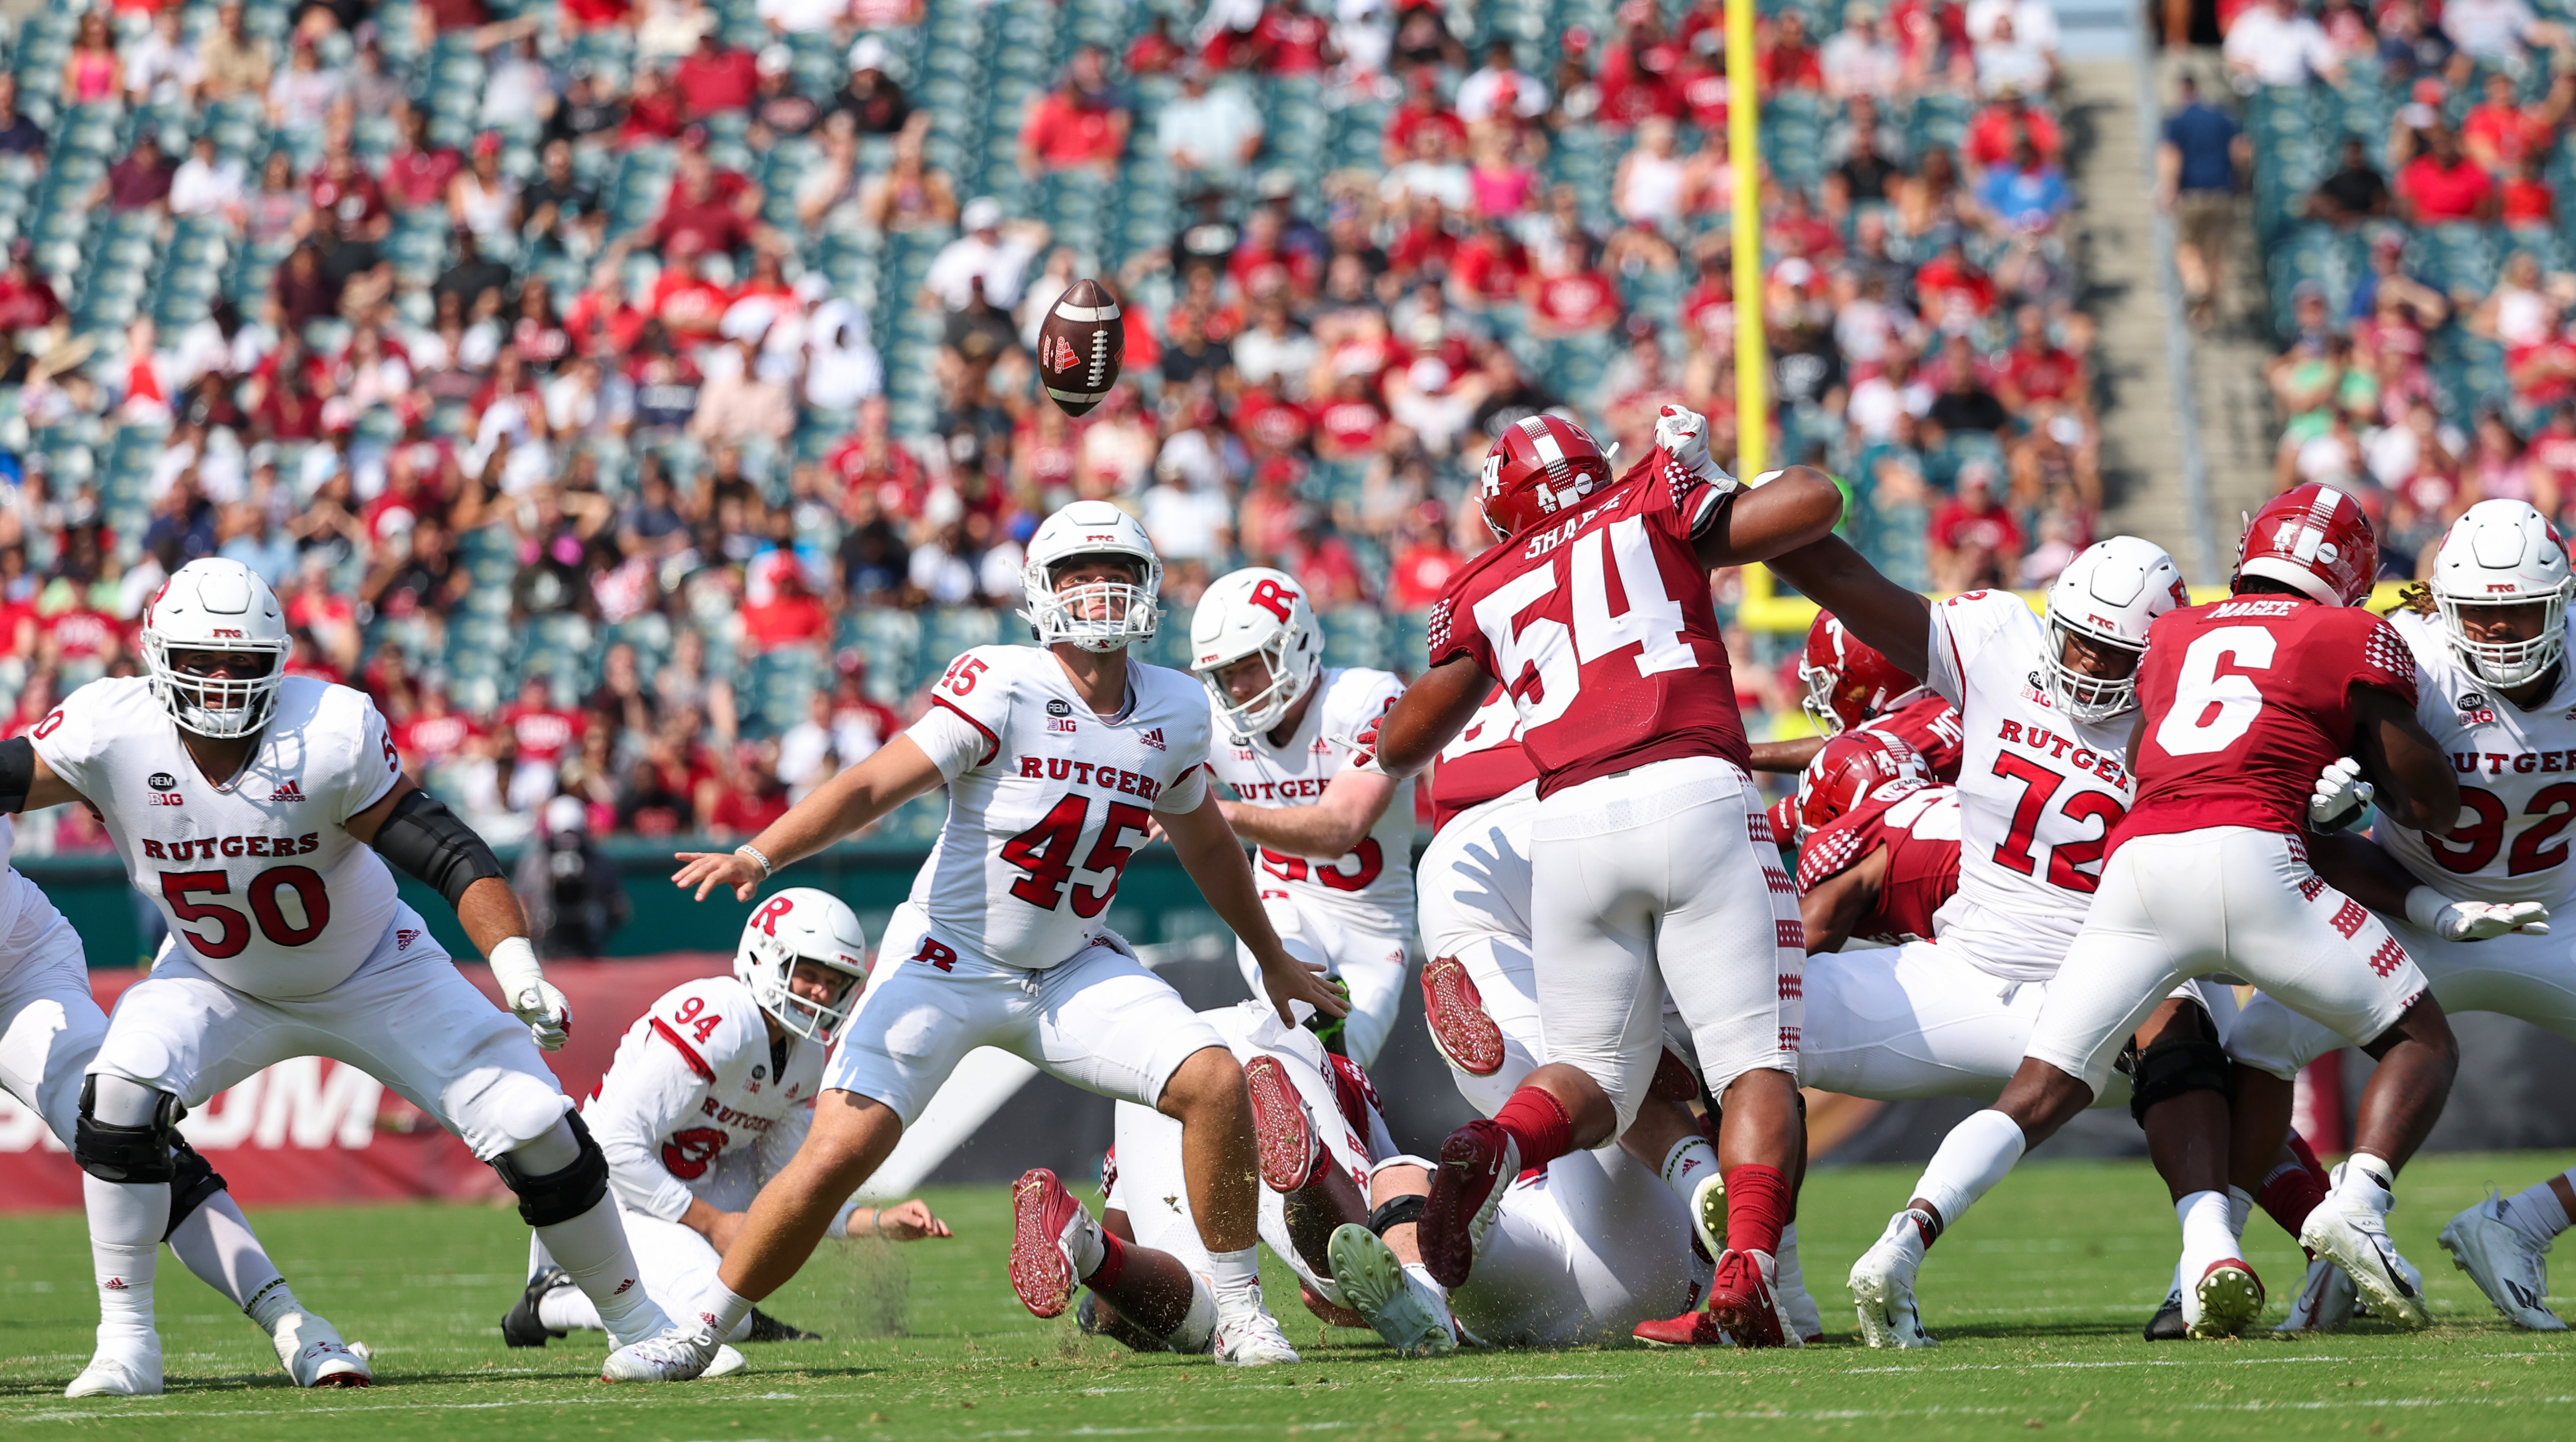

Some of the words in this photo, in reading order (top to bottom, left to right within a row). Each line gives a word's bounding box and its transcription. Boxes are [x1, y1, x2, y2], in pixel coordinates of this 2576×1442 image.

[1055, 336, 1065, 374] adidas
[1543, 503, 1556, 514] P6
[1249, 579, 1299, 624] R
[2486, 584, 2516, 593] FTG
[1472, 513, 1700, 732] 54
[2087, 613, 2115, 631] FTG
[2205, 601, 2299, 619] MAGEE
[213, 629, 241, 638] FTG
[942, 654, 990, 697] 45
[2156, 625, 2278, 757] 6
[1048, 703, 1068, 713] REM
[2459, 695, 2482, 708] REM
[1140, 737, 1167, 751] adidas
[150, 777, 173, 787] REM
[1020, 757, 1161, 804] RUTGERS
[1991, 749, 2127, 894] 72
[2422, 781, 2576, 877] 92
[142, 832, 319, 861] RUTGERS
[999, 792, 1153, 919] 45
[159, 865, 330, 959] 50
[751, 896, 793, 937] R
[398, 929, 421, 951] adidas
[911, 937, 957, 973] R
[675, 997, 722, 1044] 94
